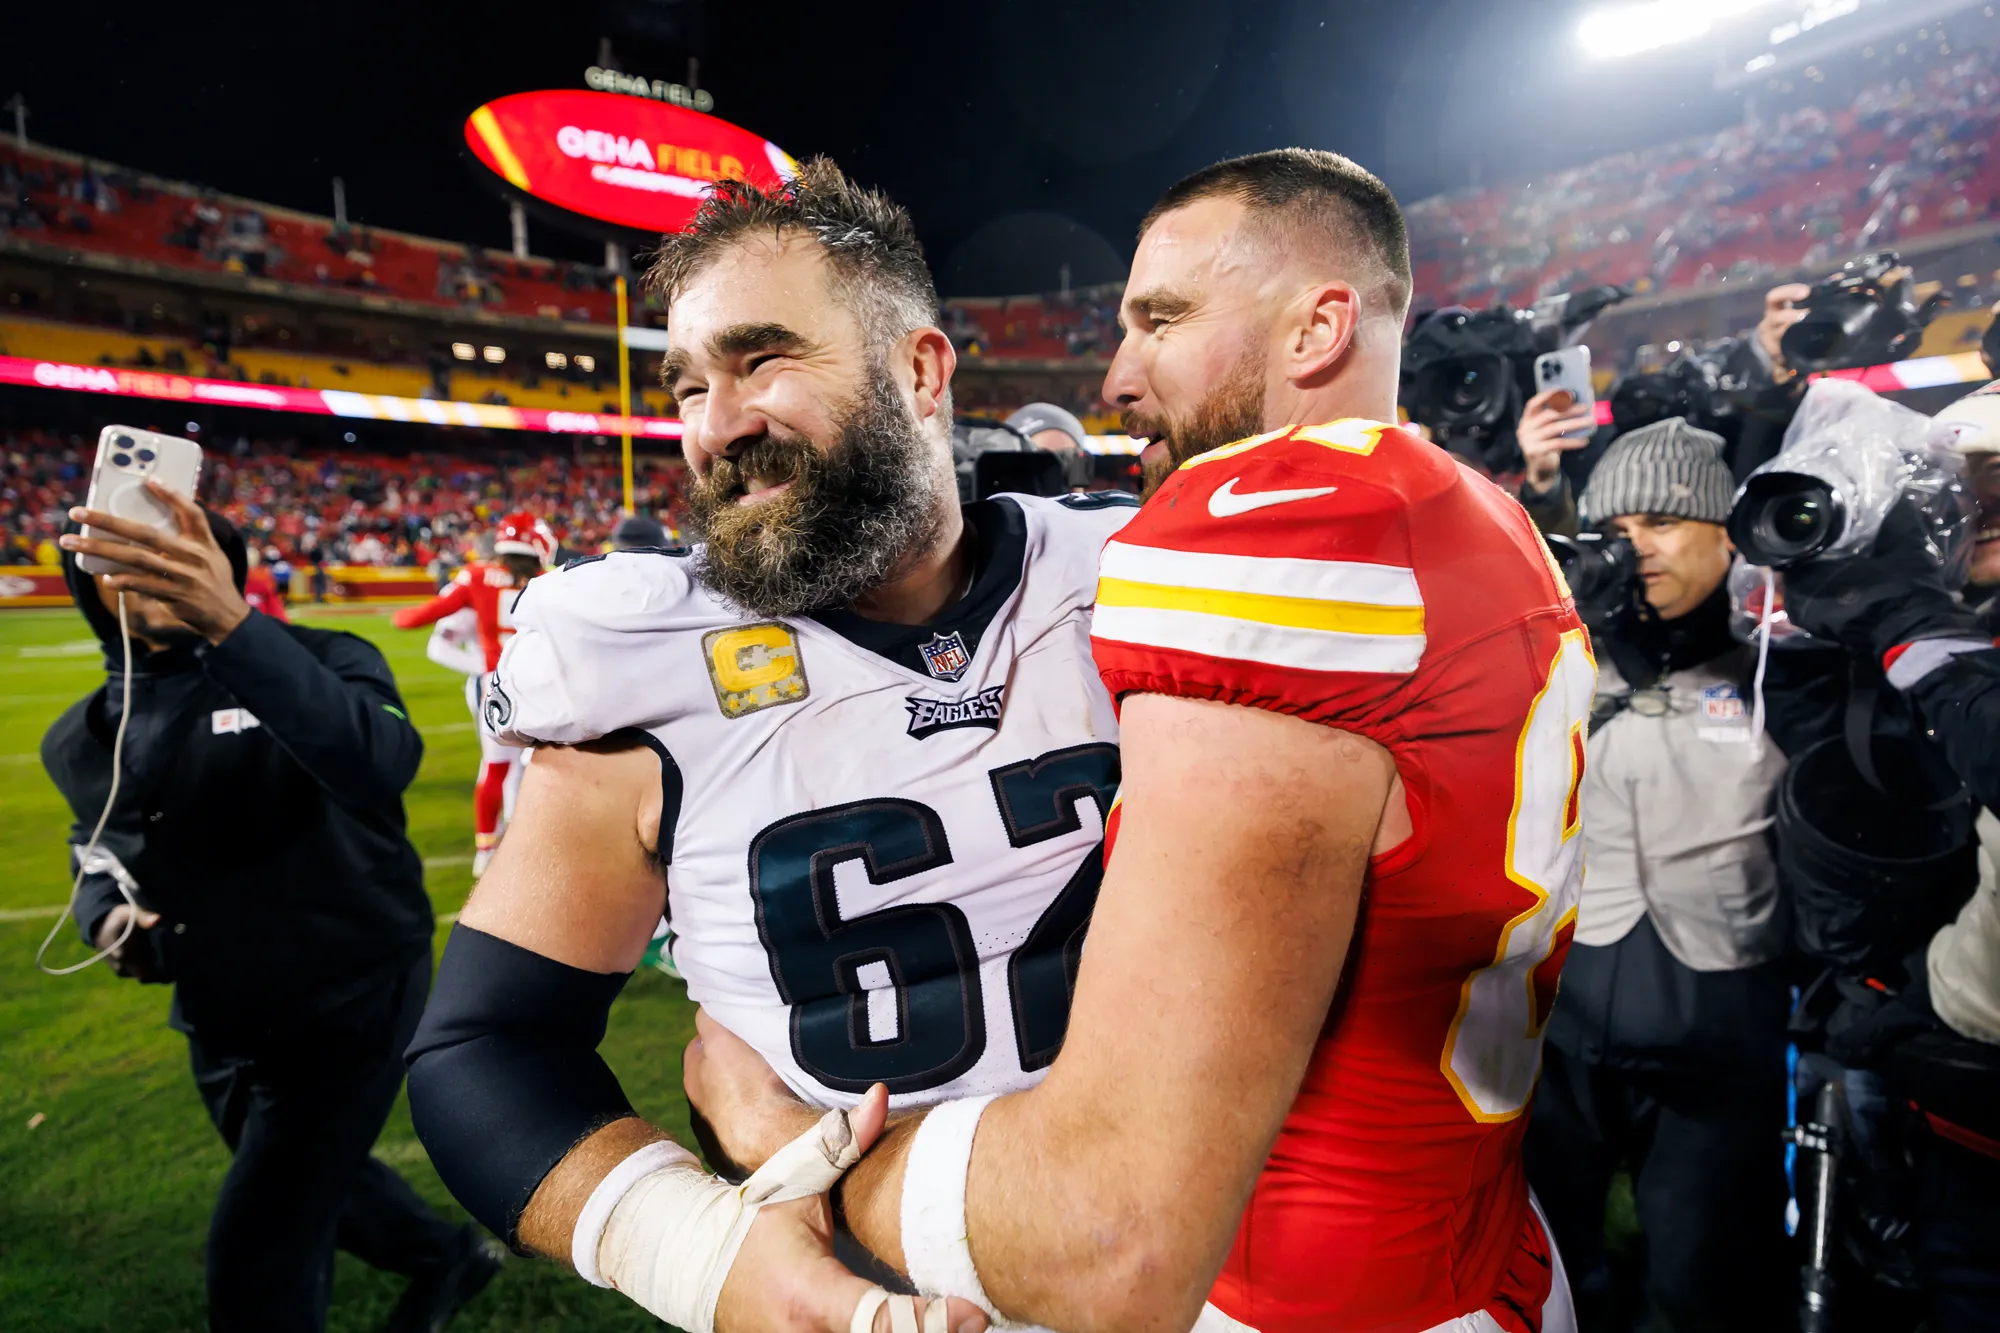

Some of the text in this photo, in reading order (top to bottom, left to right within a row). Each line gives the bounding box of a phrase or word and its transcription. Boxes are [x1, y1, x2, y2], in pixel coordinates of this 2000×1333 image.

[556, 126, 655, 171] GEHA
[712, 627, 795, 692] C
[931, 647, 969, 673] NFL
[905, 687, 1004, 735] EAGLES
[748, 742, 1121, 1094] 62
